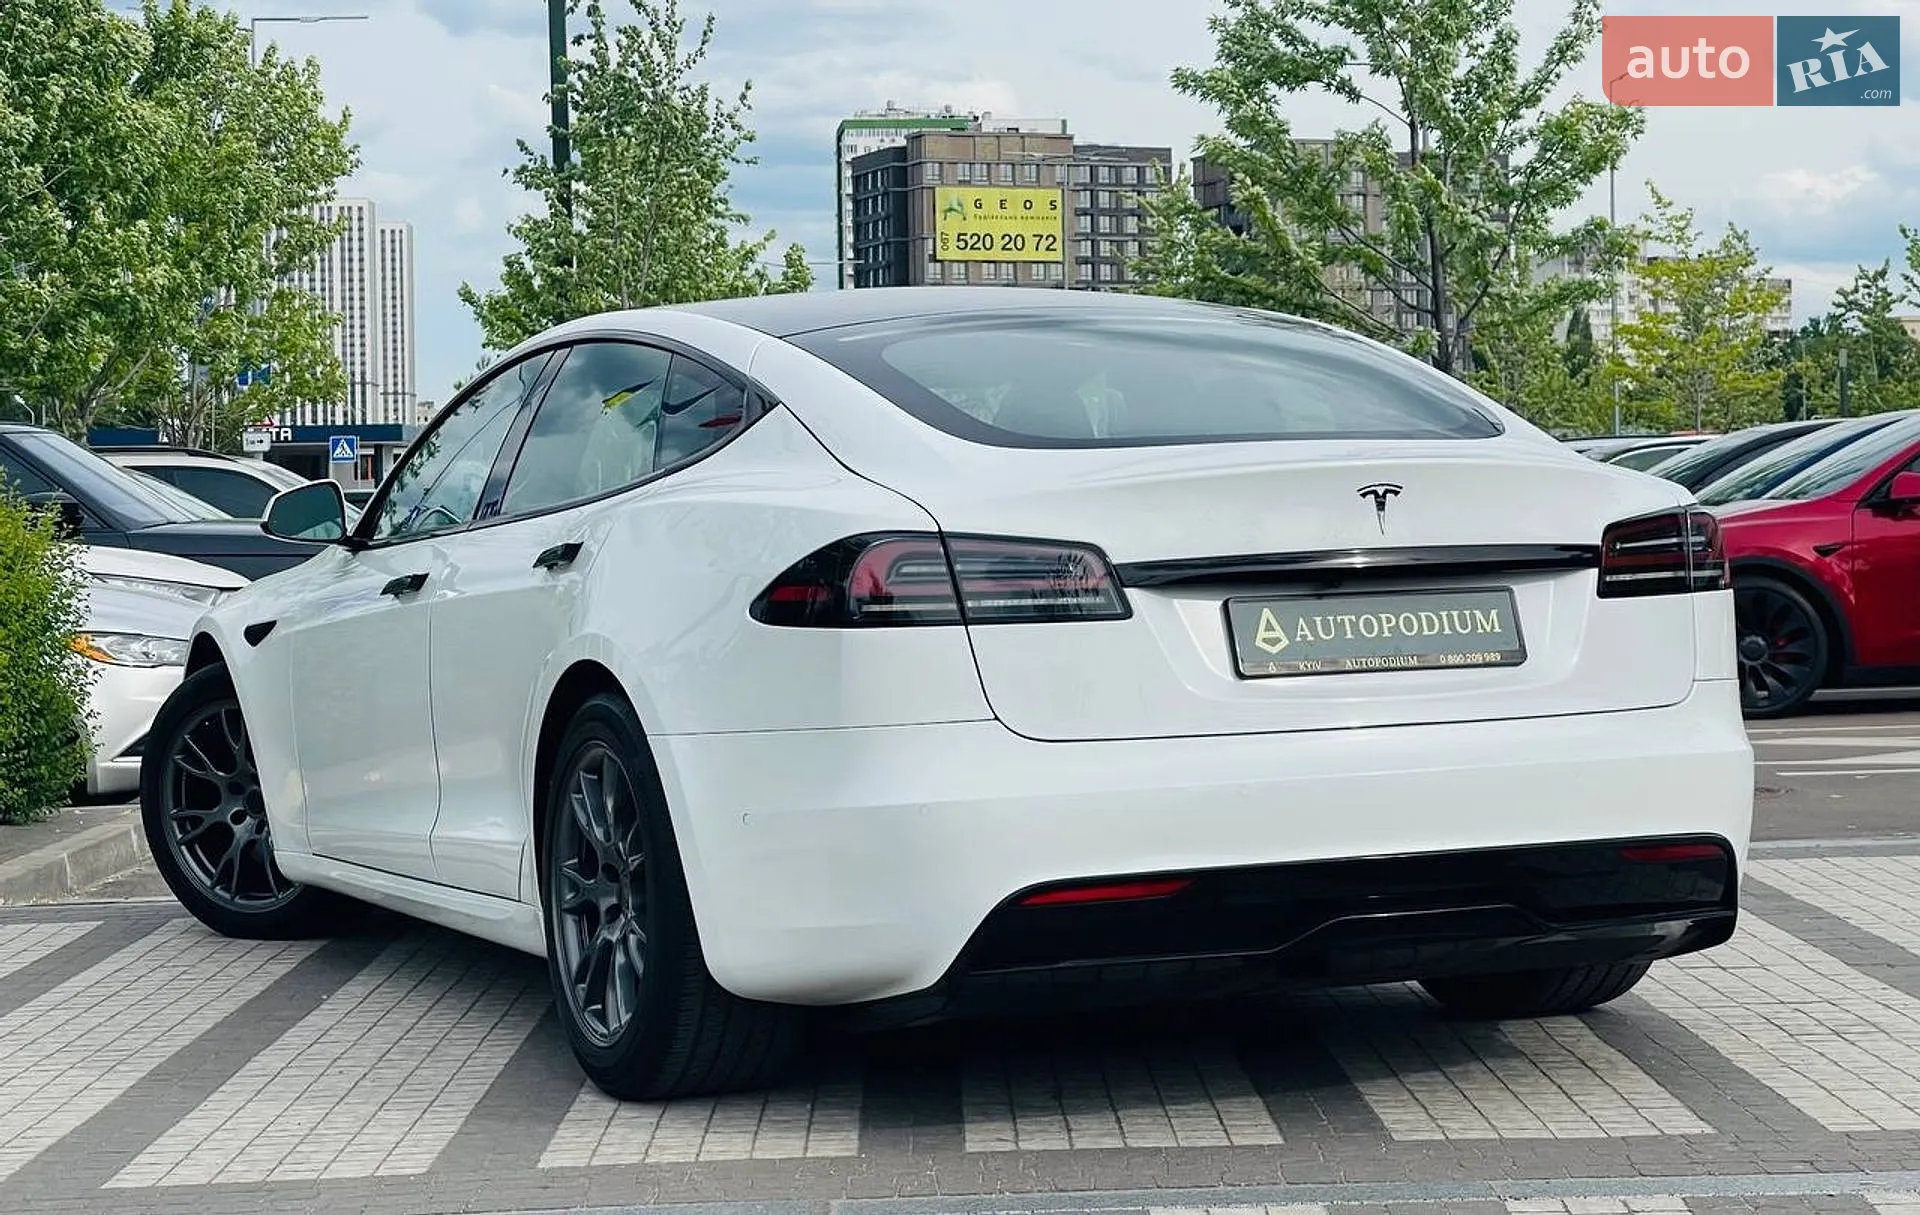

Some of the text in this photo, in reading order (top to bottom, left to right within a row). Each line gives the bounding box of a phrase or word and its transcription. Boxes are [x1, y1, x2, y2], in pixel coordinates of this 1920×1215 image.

[973, 198, 1058, 211] GEOS
[955, 232, 1058, 252] 520 20 72
[1295, 608, 1502, 641] AUTOPODIUM
[1298, 661, 1321, 671] KYIV
[1345, 655, 1418, 670] AUTOPODIUM
